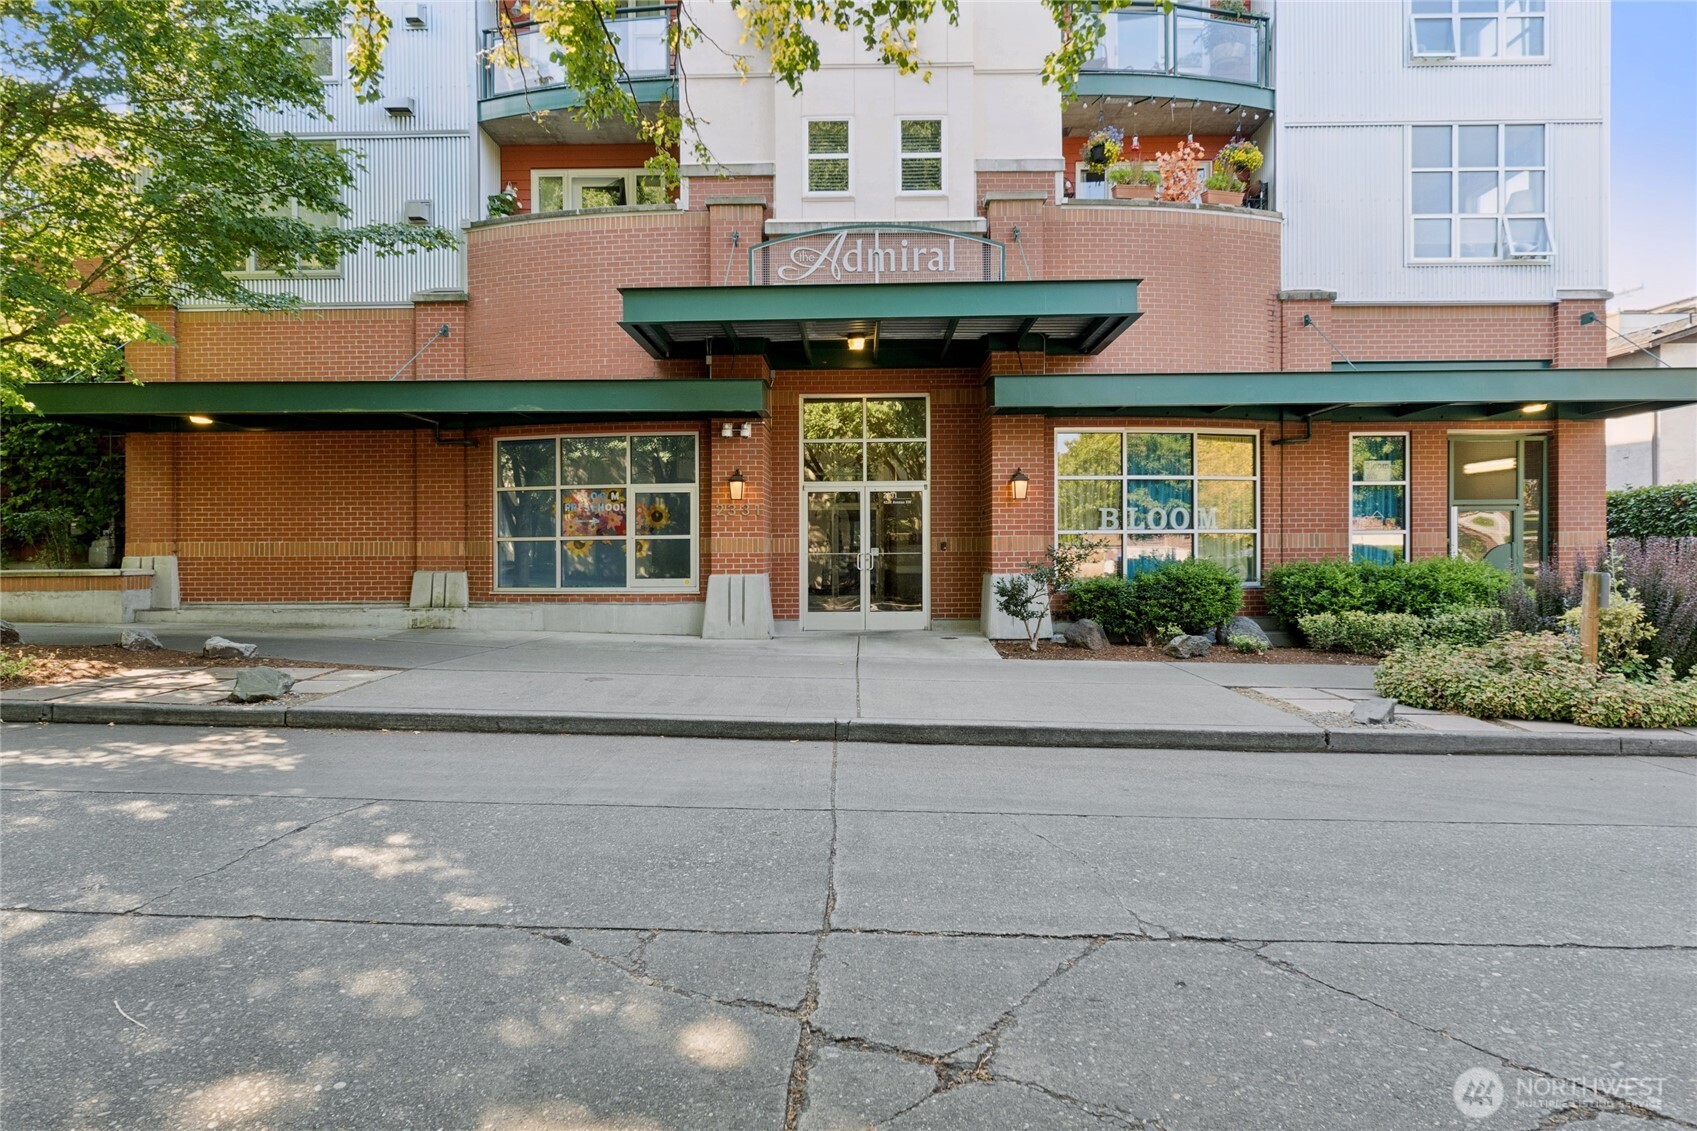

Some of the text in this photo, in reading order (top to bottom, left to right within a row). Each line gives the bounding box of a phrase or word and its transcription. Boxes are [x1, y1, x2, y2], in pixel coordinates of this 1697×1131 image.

[778, 230, 956, 281] the Admiral
[716, 504, 760, 516] 2331
[1098, 507, 1219, 530] BLOOM
